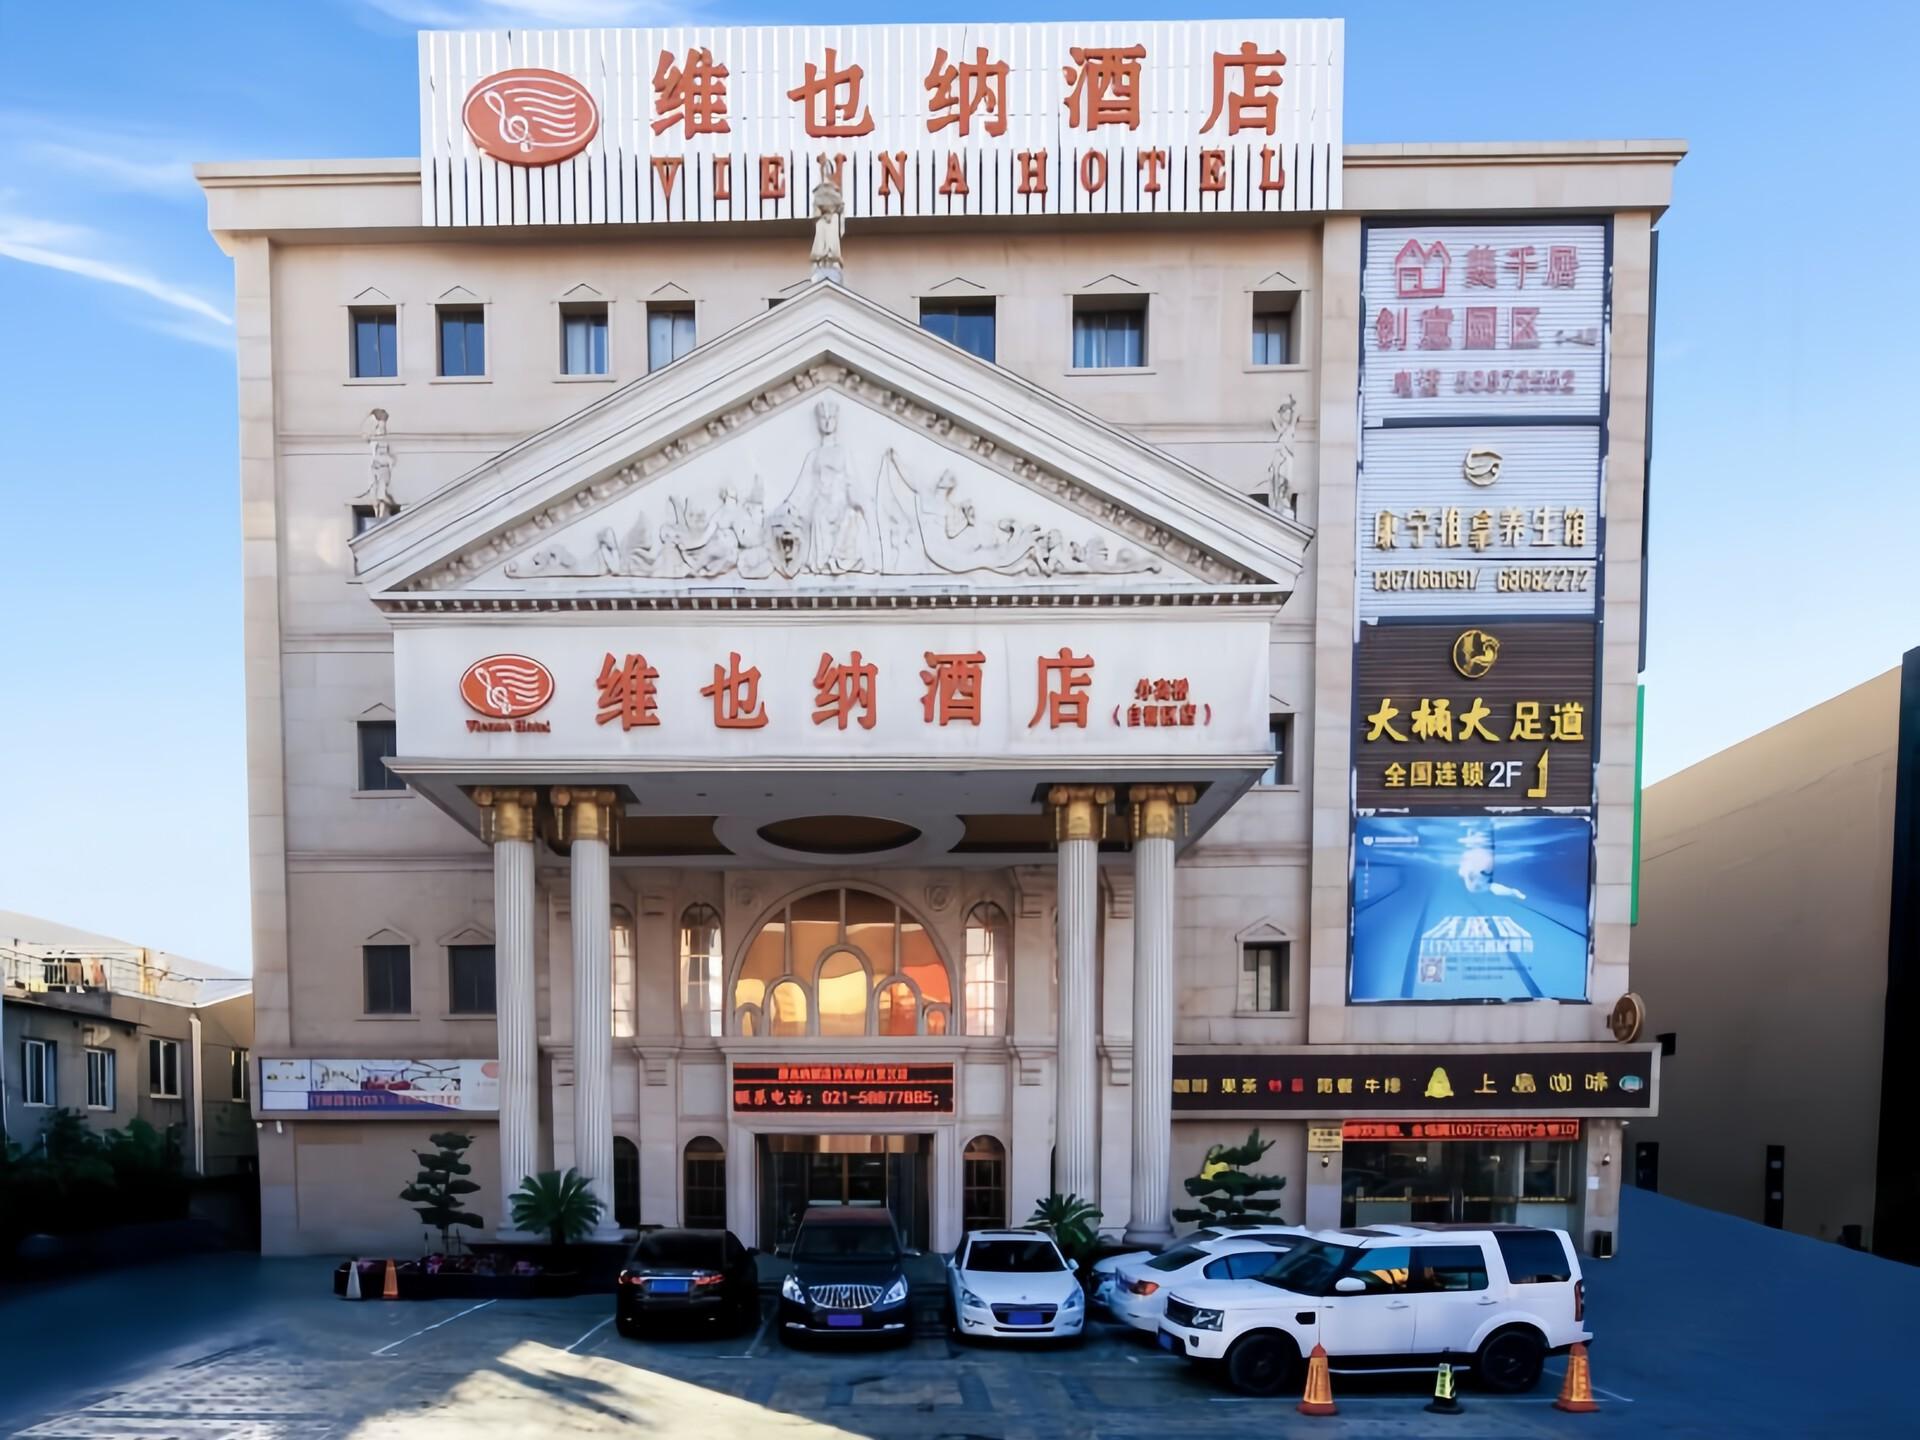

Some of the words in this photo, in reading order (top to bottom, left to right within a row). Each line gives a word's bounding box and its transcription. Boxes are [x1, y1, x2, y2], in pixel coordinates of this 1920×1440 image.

[650, 42, 1286, 139] 维也纳酒店
[1017, 148, 1285, 194] HOTEL
[595, 647, 1095, 732] 维也纳酒店
[1384, 762, 1484, 787] 全国连锁
[1487, 761, 1523, 787] 2F
